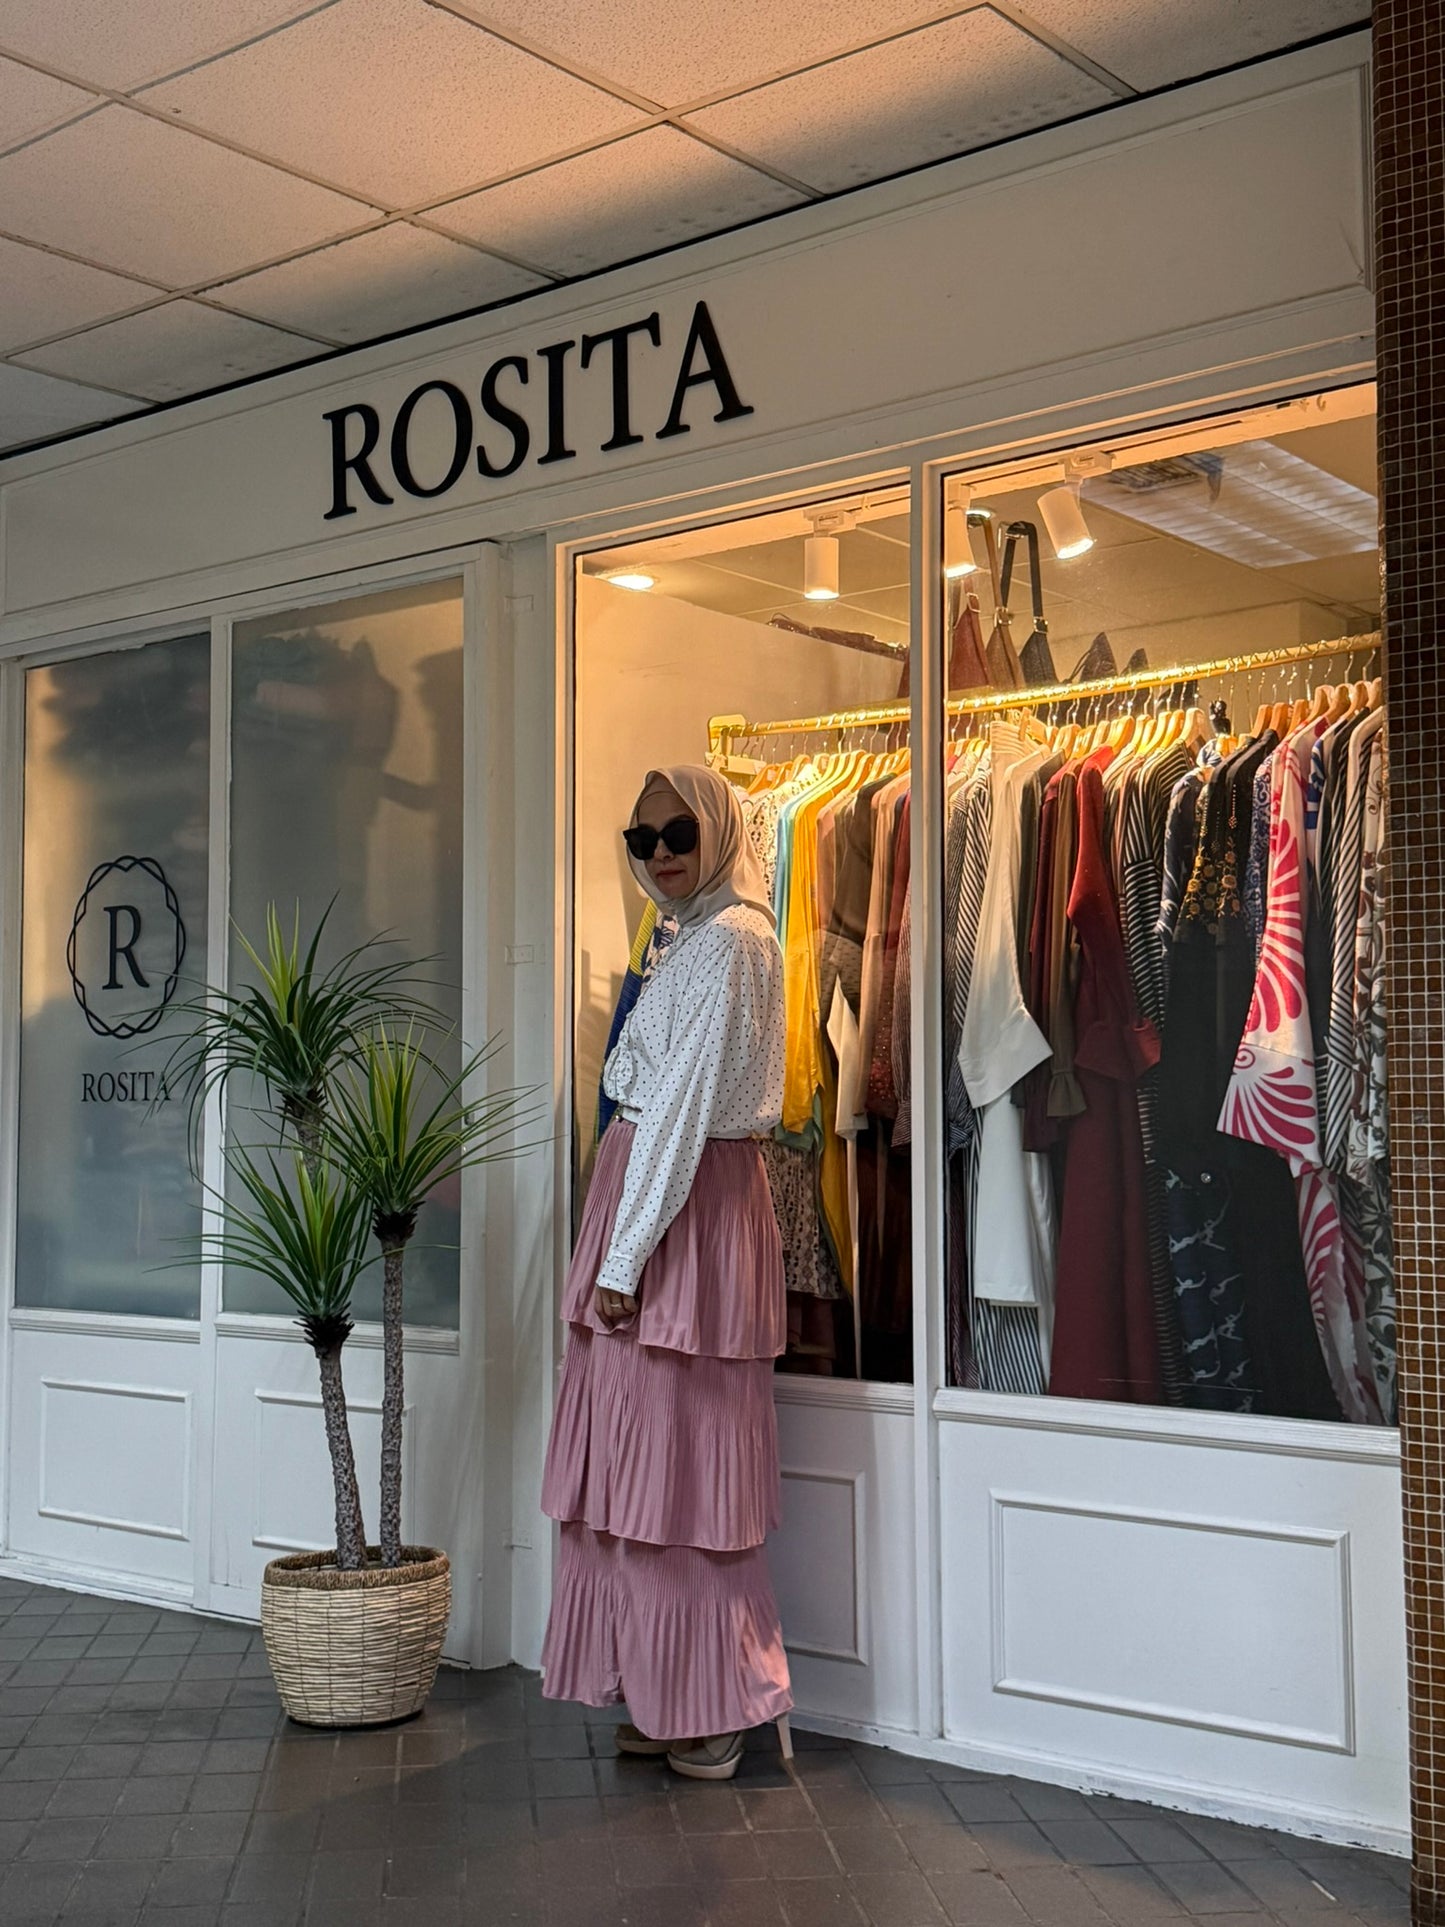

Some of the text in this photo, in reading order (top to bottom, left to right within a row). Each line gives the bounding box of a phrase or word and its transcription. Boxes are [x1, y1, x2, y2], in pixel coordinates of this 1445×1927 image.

[322, 300, 754, 520] ROSITA
[102, 904, 150, 990] R
[81, 1071, 171, 1102] ROSITA
